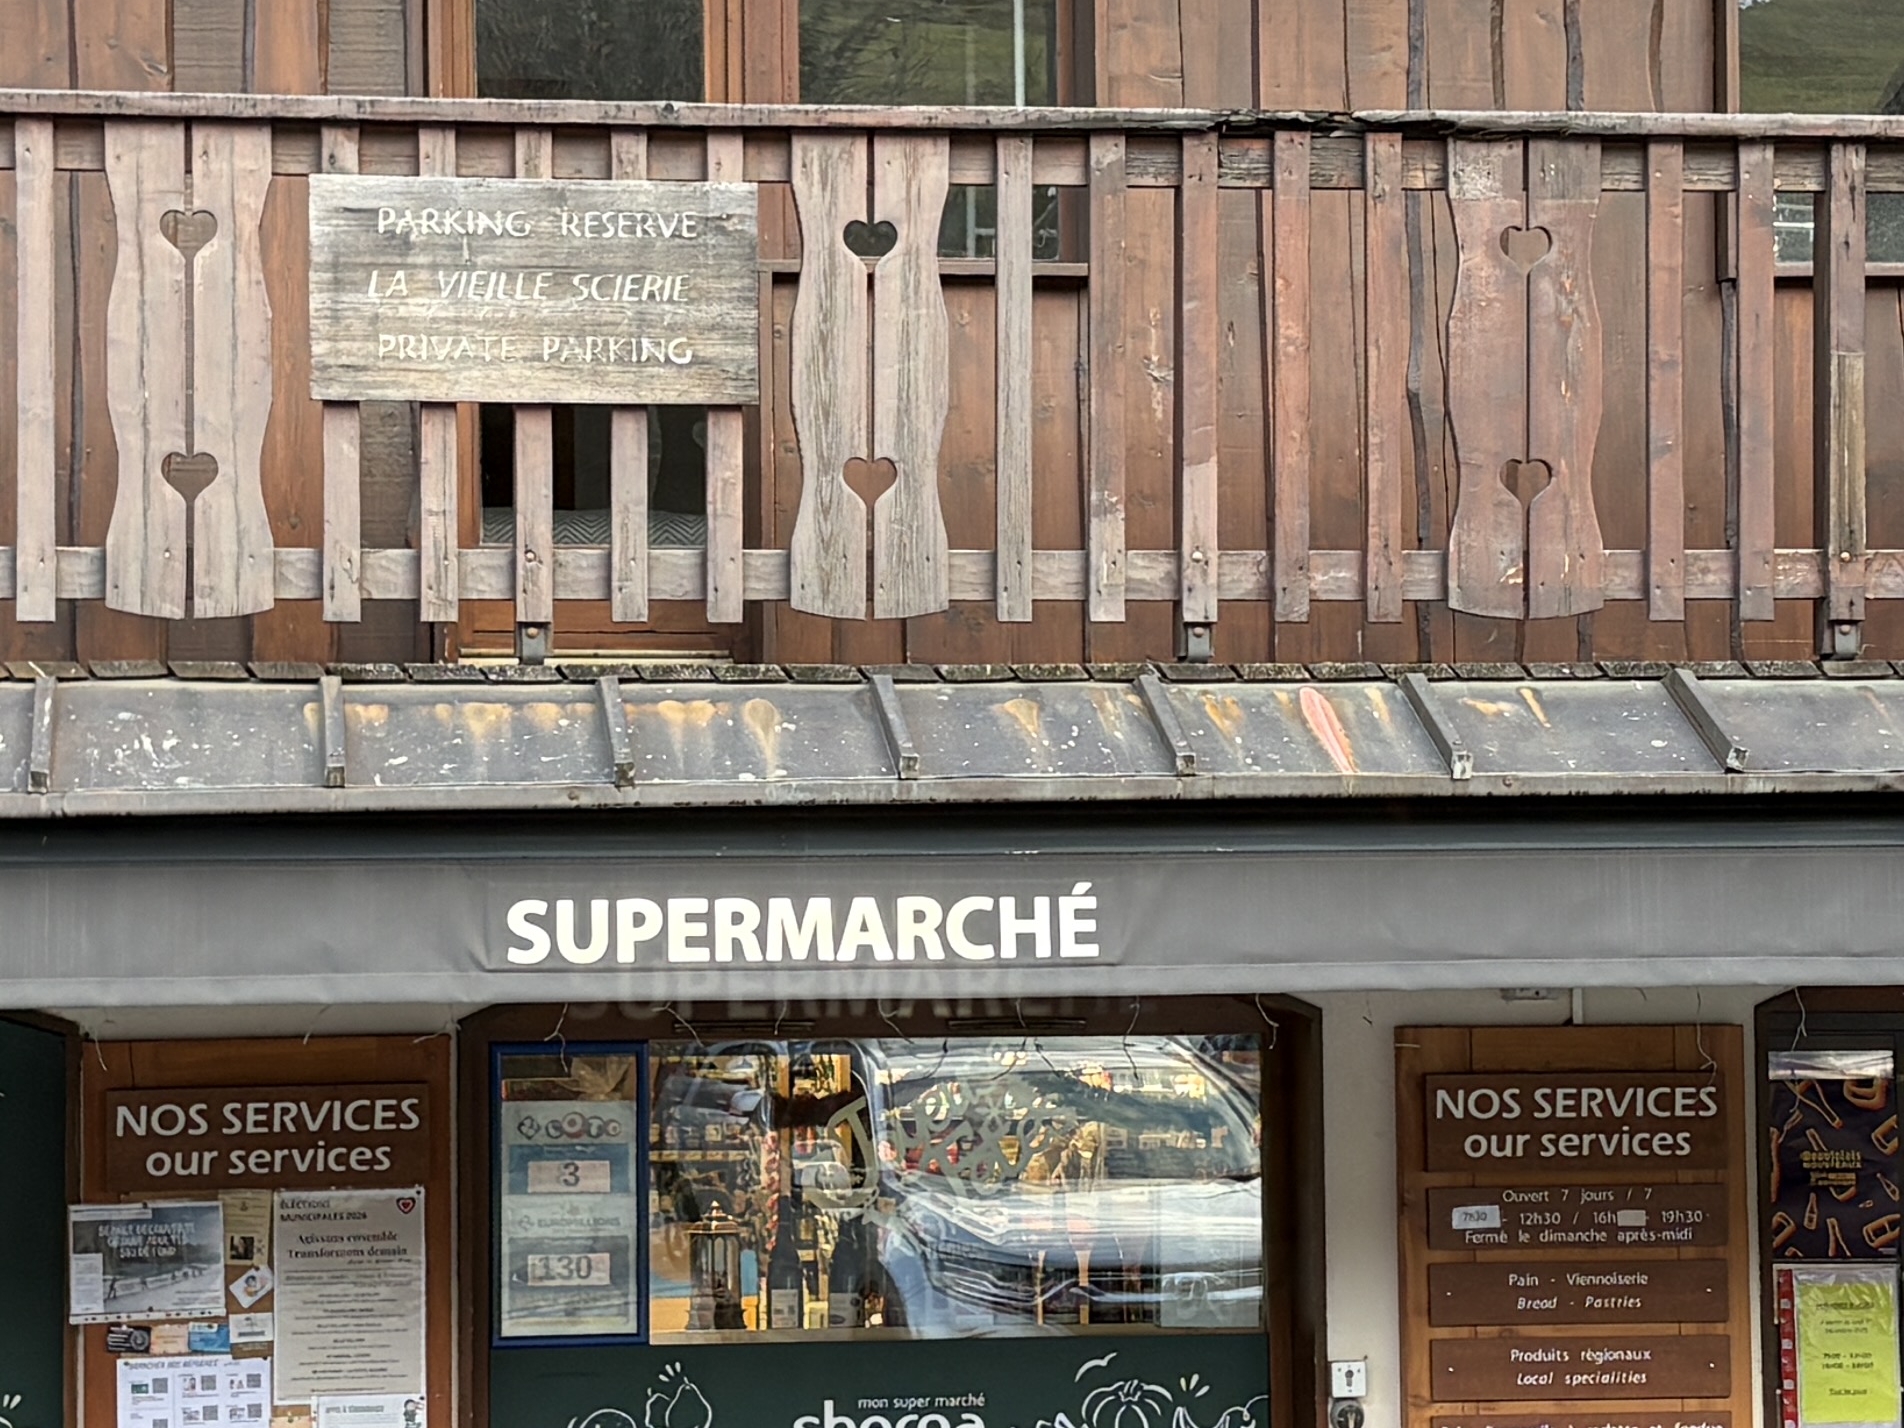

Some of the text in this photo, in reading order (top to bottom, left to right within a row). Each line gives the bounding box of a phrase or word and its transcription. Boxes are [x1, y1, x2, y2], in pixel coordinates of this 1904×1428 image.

[377, 206, 532, 238] PARKING
[367, 270, 690, 303] LA VIEILLE SCIERIE
[377, 333, 694, 366] PRIVATE PARKING
[504, 881, 1101, 965] SUPERMARCHÉ
[1435, 1086, 1719, 1120] NOS SERVICES
[116, 1098, 420, 1137] NOS SERVICES
[1464, 1125, 1692, 1158] our services
[146, 1141, 392, 1176] our services
[562, 1161, 580, 1188] 3
[1502, 1189, 1550, 1203] Ouvert
[1560, 1189, 1569, 1202] 7
[1579, 1188, 1615, 1206] jours
[1644, 1187, 1653, 1200] 7
[1519, 1211, 1562, 1225] 12h30
[1660, 1209, 1703, 1223] 19h30
[1465, 1226, 1693, 1244] Fermé le dimanche après-midi
[1508, 1272, 1649, 1287] Pain Viennoiserie
[1516, 1295, 1642, 1310] Bread Pastries
[1510, 1348, 1652, 1365] Produits régionaux
[1516, 1371, 1648, 1387] Local specialities
[857, 1392, 986, 1411] mon super marché
